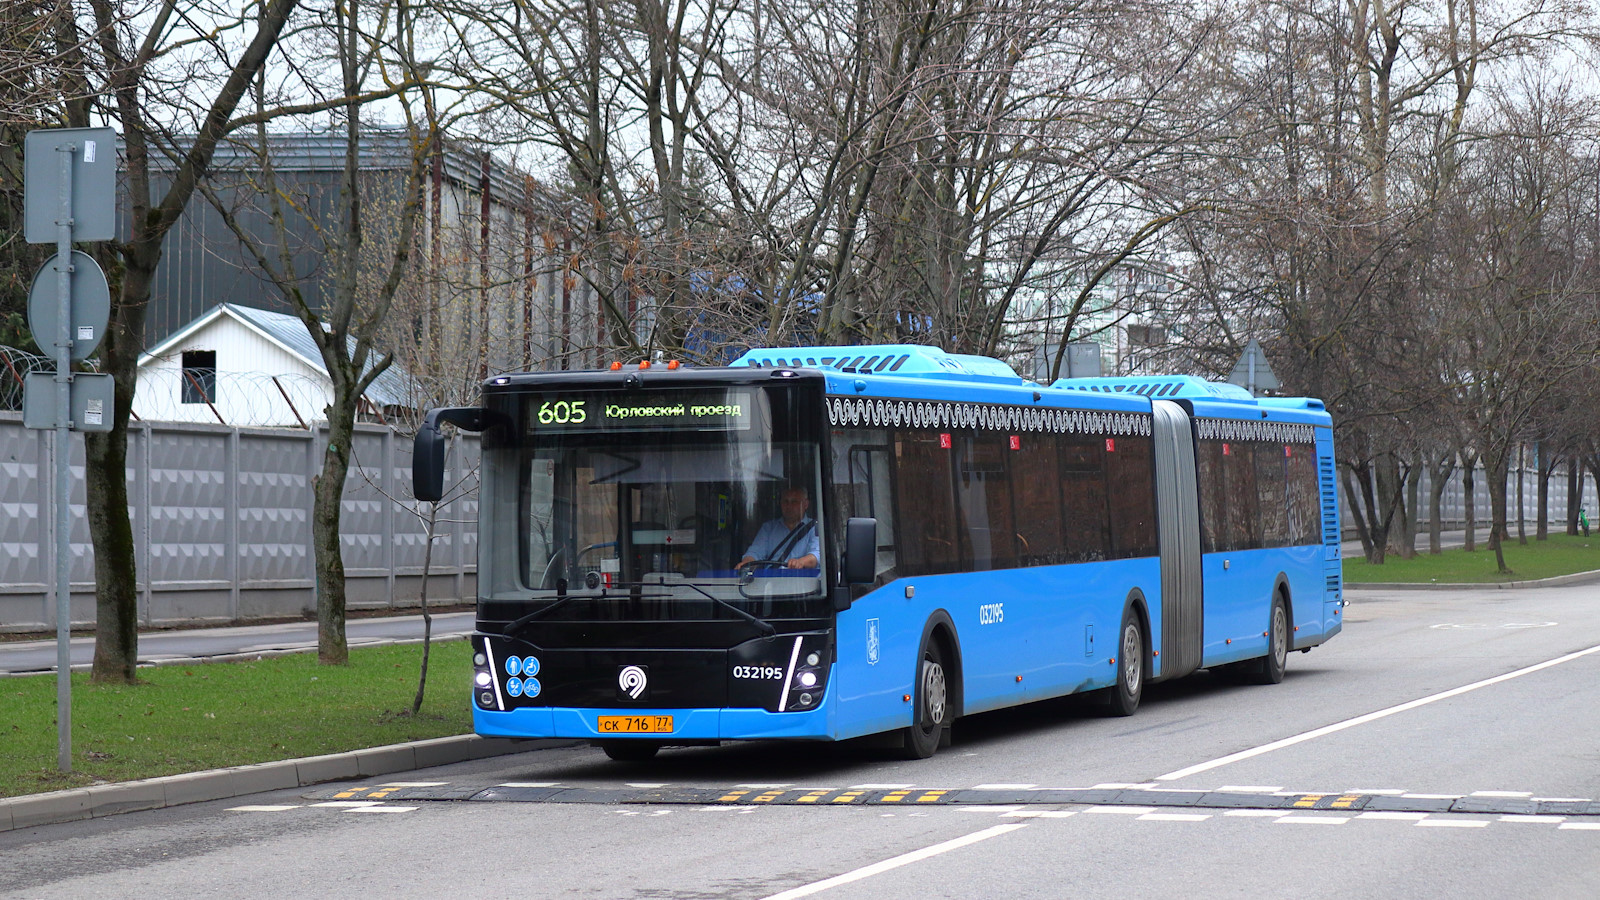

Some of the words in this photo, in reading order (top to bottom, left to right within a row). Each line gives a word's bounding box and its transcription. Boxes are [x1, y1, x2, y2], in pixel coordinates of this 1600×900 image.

[538, 401, 586, 424] 605
[605, 404, 685, 419] Юрловский
[690, 404, 742, 417] проезд
[980, 602, 1004, 625] 032195
[733, 665, 783, 680] 032195
[604, 720, 619, 730] СК
[624, 717, 649, 731] 716
[656, 717, 668, 727] 77
